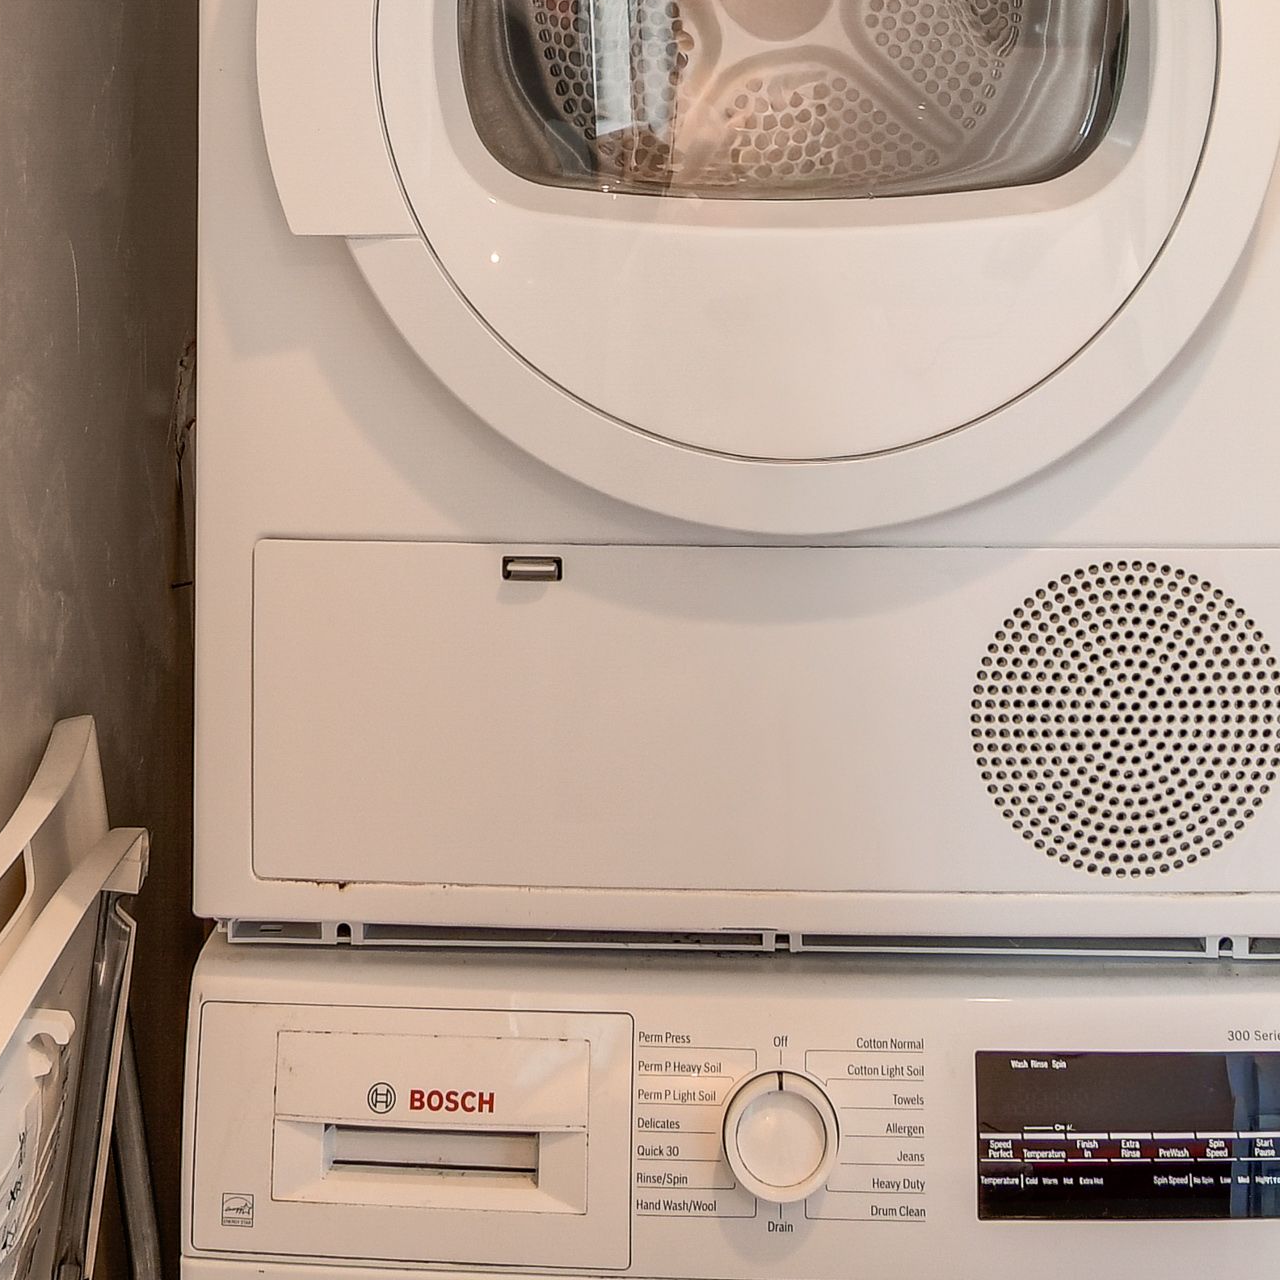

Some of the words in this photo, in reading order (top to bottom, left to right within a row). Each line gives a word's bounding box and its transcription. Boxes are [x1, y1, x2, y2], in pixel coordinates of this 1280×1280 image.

[639, 1032, 663, 1042] Perm
[665, 1033, 690, 1043] Press
[1228, 1030, 1250, 1041] 300
[773, 1037, 788, 1047] Off
[856, 1038, 886, 1049] Cotton
[890, 1039, 924, 1050] Normal
[638, 1062, 662, 1072] Perm
[665, 1062, 671, 1072] P
[673, 1062, 702, 1074] Heavy
[704, 1063, 722, 1073] Soil
[1010, 1060, 1028, 1068] Wash
[1031, 1060, 1048, 1068] Rinse
[1052, 1060, 1066, 1069] Spin
[847, 1065, 878, 1075] Cotton
[882, 1065, 905, 1078] Light
[907, 1066, 924, 1076] Soil
[410, 1090, 494, 1113] BOSCH
[638, 1090, 662, 1100] Perm
[665, 1091, 671, 1100] P
[673, 1091, 696, 1103] Light
[698, 1091, 716, 1101] Soil
[893, 1094, 924, 1105] Towels
[638, 1118, 680, 1129] Delicates
[886, 1123, 924, 1136] Allergen
[989, 1140, 1012, 1149] Speed
[1077, 1140, 1098, 1149] Finish
[1121, 1140, 1140, 1149] Extra
[1209, 1139, 1224, 1149] Spin
[1256, 1139, 1273, 1147] Start
[637, 1146, 664, 1156] Quick
[666, 1146, 679, 1156] 30
[897, 1151, 924, 1162] Jeans
[989, 1149, 1013, 1158] Perfect
[1023, 1149, 1066, 1159] Temperature
[1121, 1150, 1140, 1158] Rinse
[1159, 1148, 1189, 1157] PreWash
[1206, 1148, 1228, 1158] Speed
[1255, 1148, 1275, 1156] Pause
[637, 1173, 688, 1185] Rinse/Spin
[980, 1176, 1019, 1186] Temperature
[1153, 1175, 1168, 1186] Spin
[1169, 1175, 1188, 1186] Speed
[872, 1178, 901, 1191] Heavy
[903, 1179, 925, 1192] Duty
[636, 1200, 661, 1211] Hand
[663, 1201, 716, 1212] Wash/Wool
[871, 1205, 897, 1217] Drum
[899, 1206, 926, 1217] Clean
[768, 1221, 793, 1233] Drain
